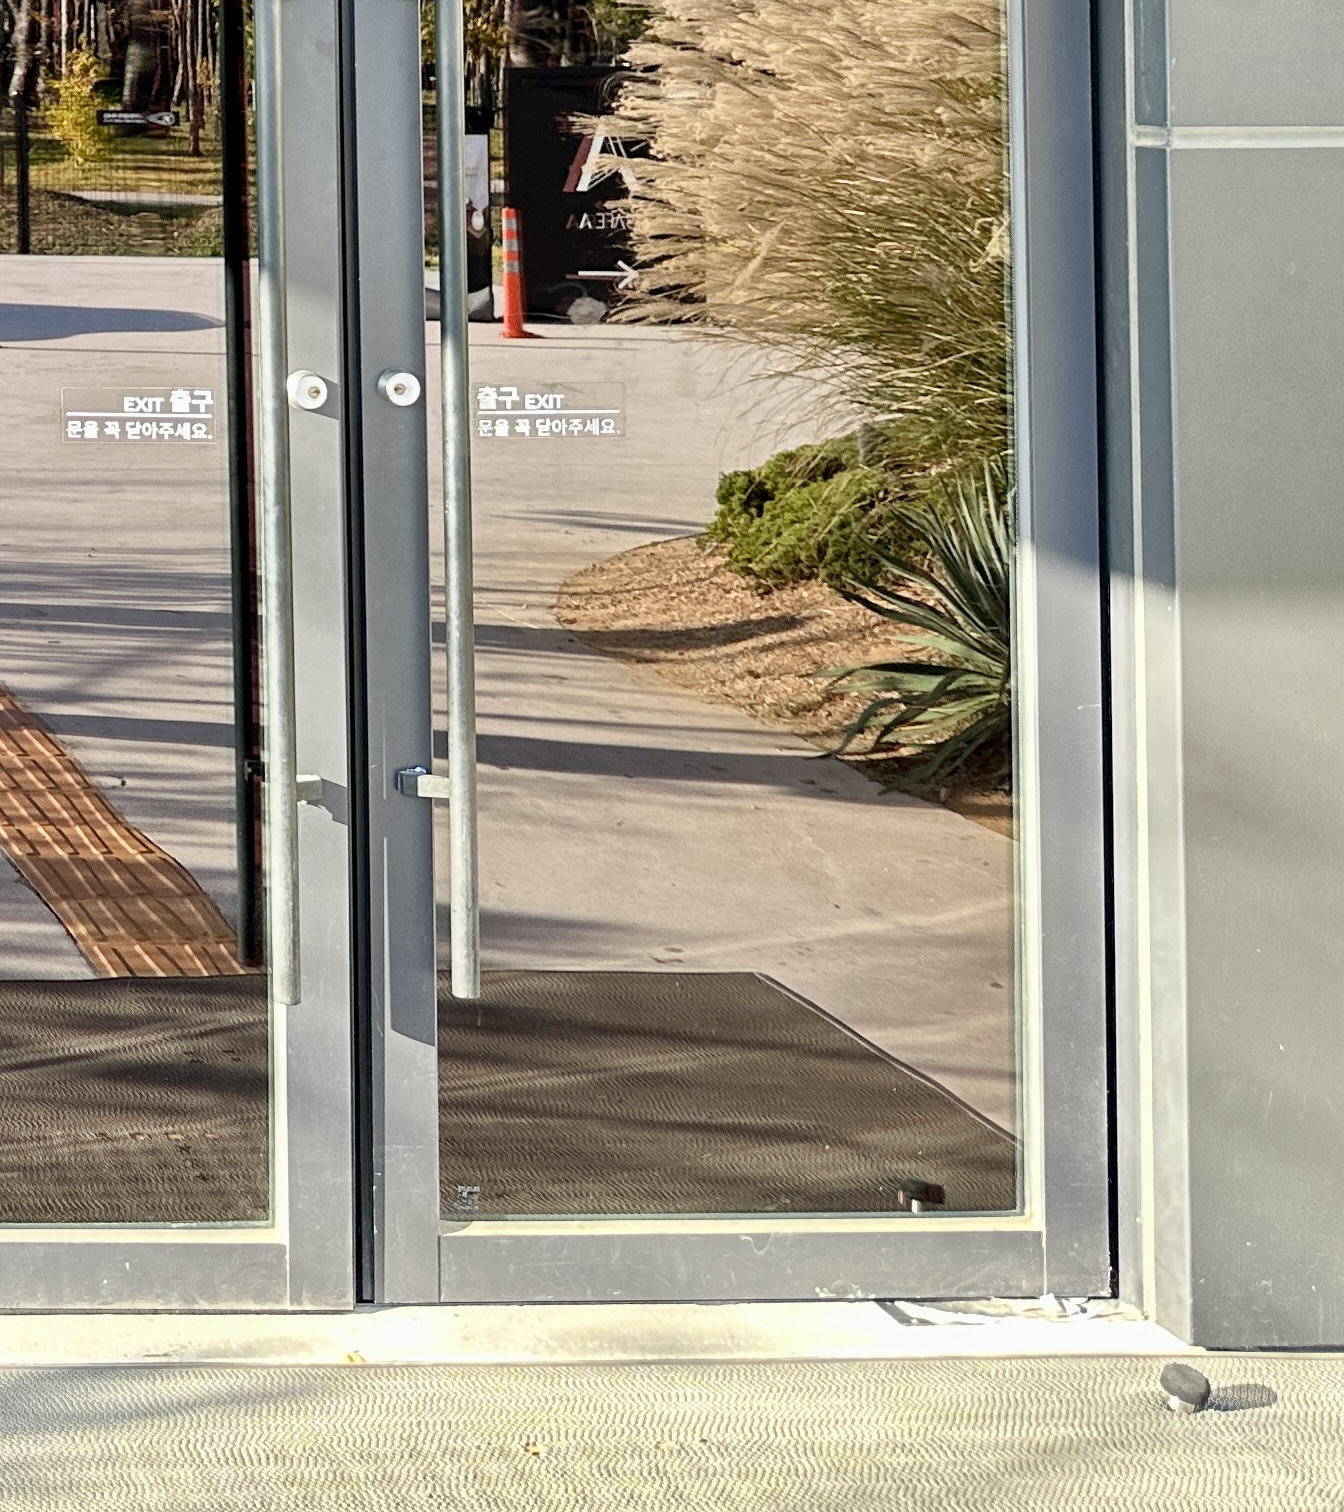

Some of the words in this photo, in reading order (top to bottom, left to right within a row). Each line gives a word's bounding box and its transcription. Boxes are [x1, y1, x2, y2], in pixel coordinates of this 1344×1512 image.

[123, 396, 165, 413] EXIT
[169, 388, 214, 413] 출구
[476, 385, 520, 410] 출구
[524, 393, 565, 410] EXIT
[66, 420, 100, 439] 문을
[103, 421, 121, 439] 꼭
[125, 421, 213, 441] 닫아주세요.
[477, 418, 510, 437] 문을
[514, 418, 531, 437] 꼭
[535, 417, 620, 437] 닫아주세요.
